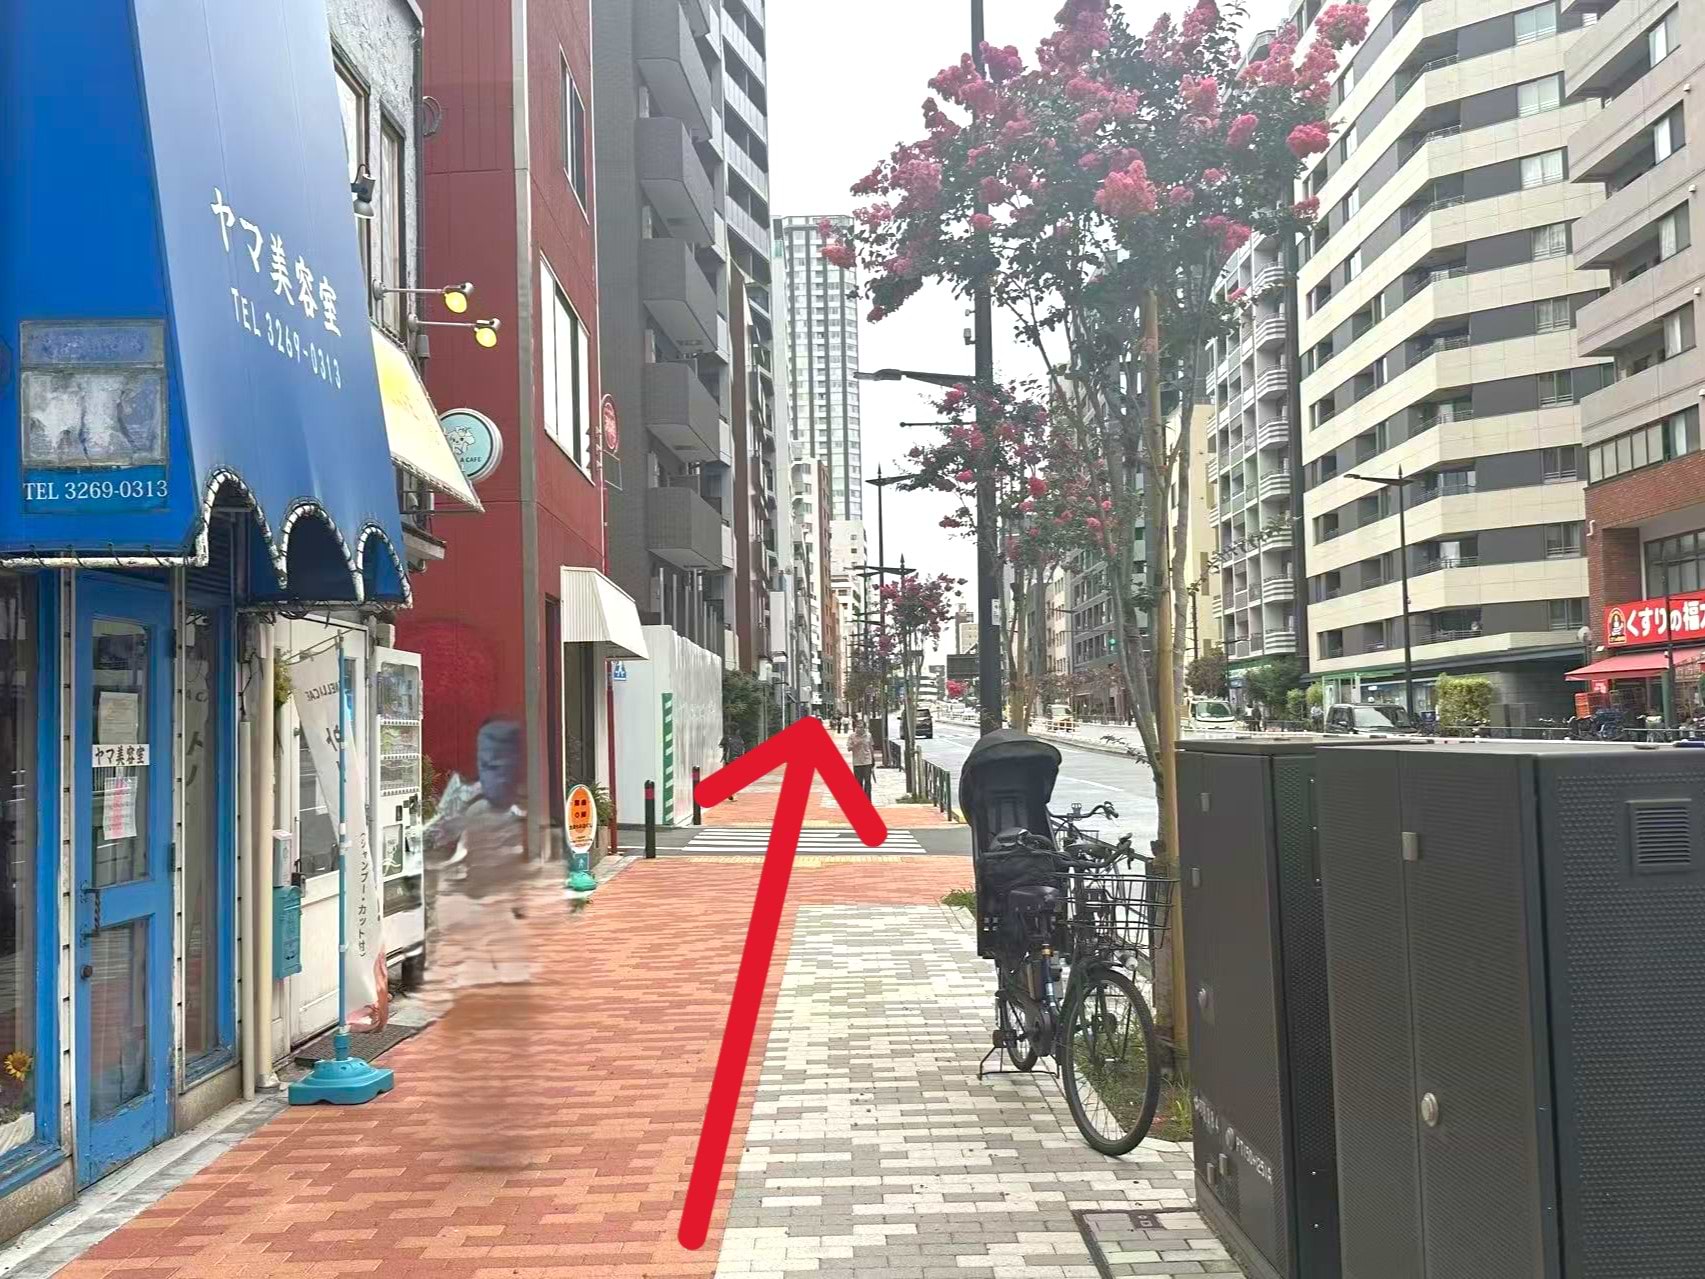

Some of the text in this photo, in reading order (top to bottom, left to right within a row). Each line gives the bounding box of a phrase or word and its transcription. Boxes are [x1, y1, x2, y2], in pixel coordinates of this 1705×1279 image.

[210, 187, 342, 338] ヤマ美容室
[230, 287, 342, 390] TEL 3269-0313
[23, 480, 168, 501] TEL 3269-0313
[1626, 600, 1705, 637] くすりの福
[95, 745, 146, 767] ヤマ美容室
